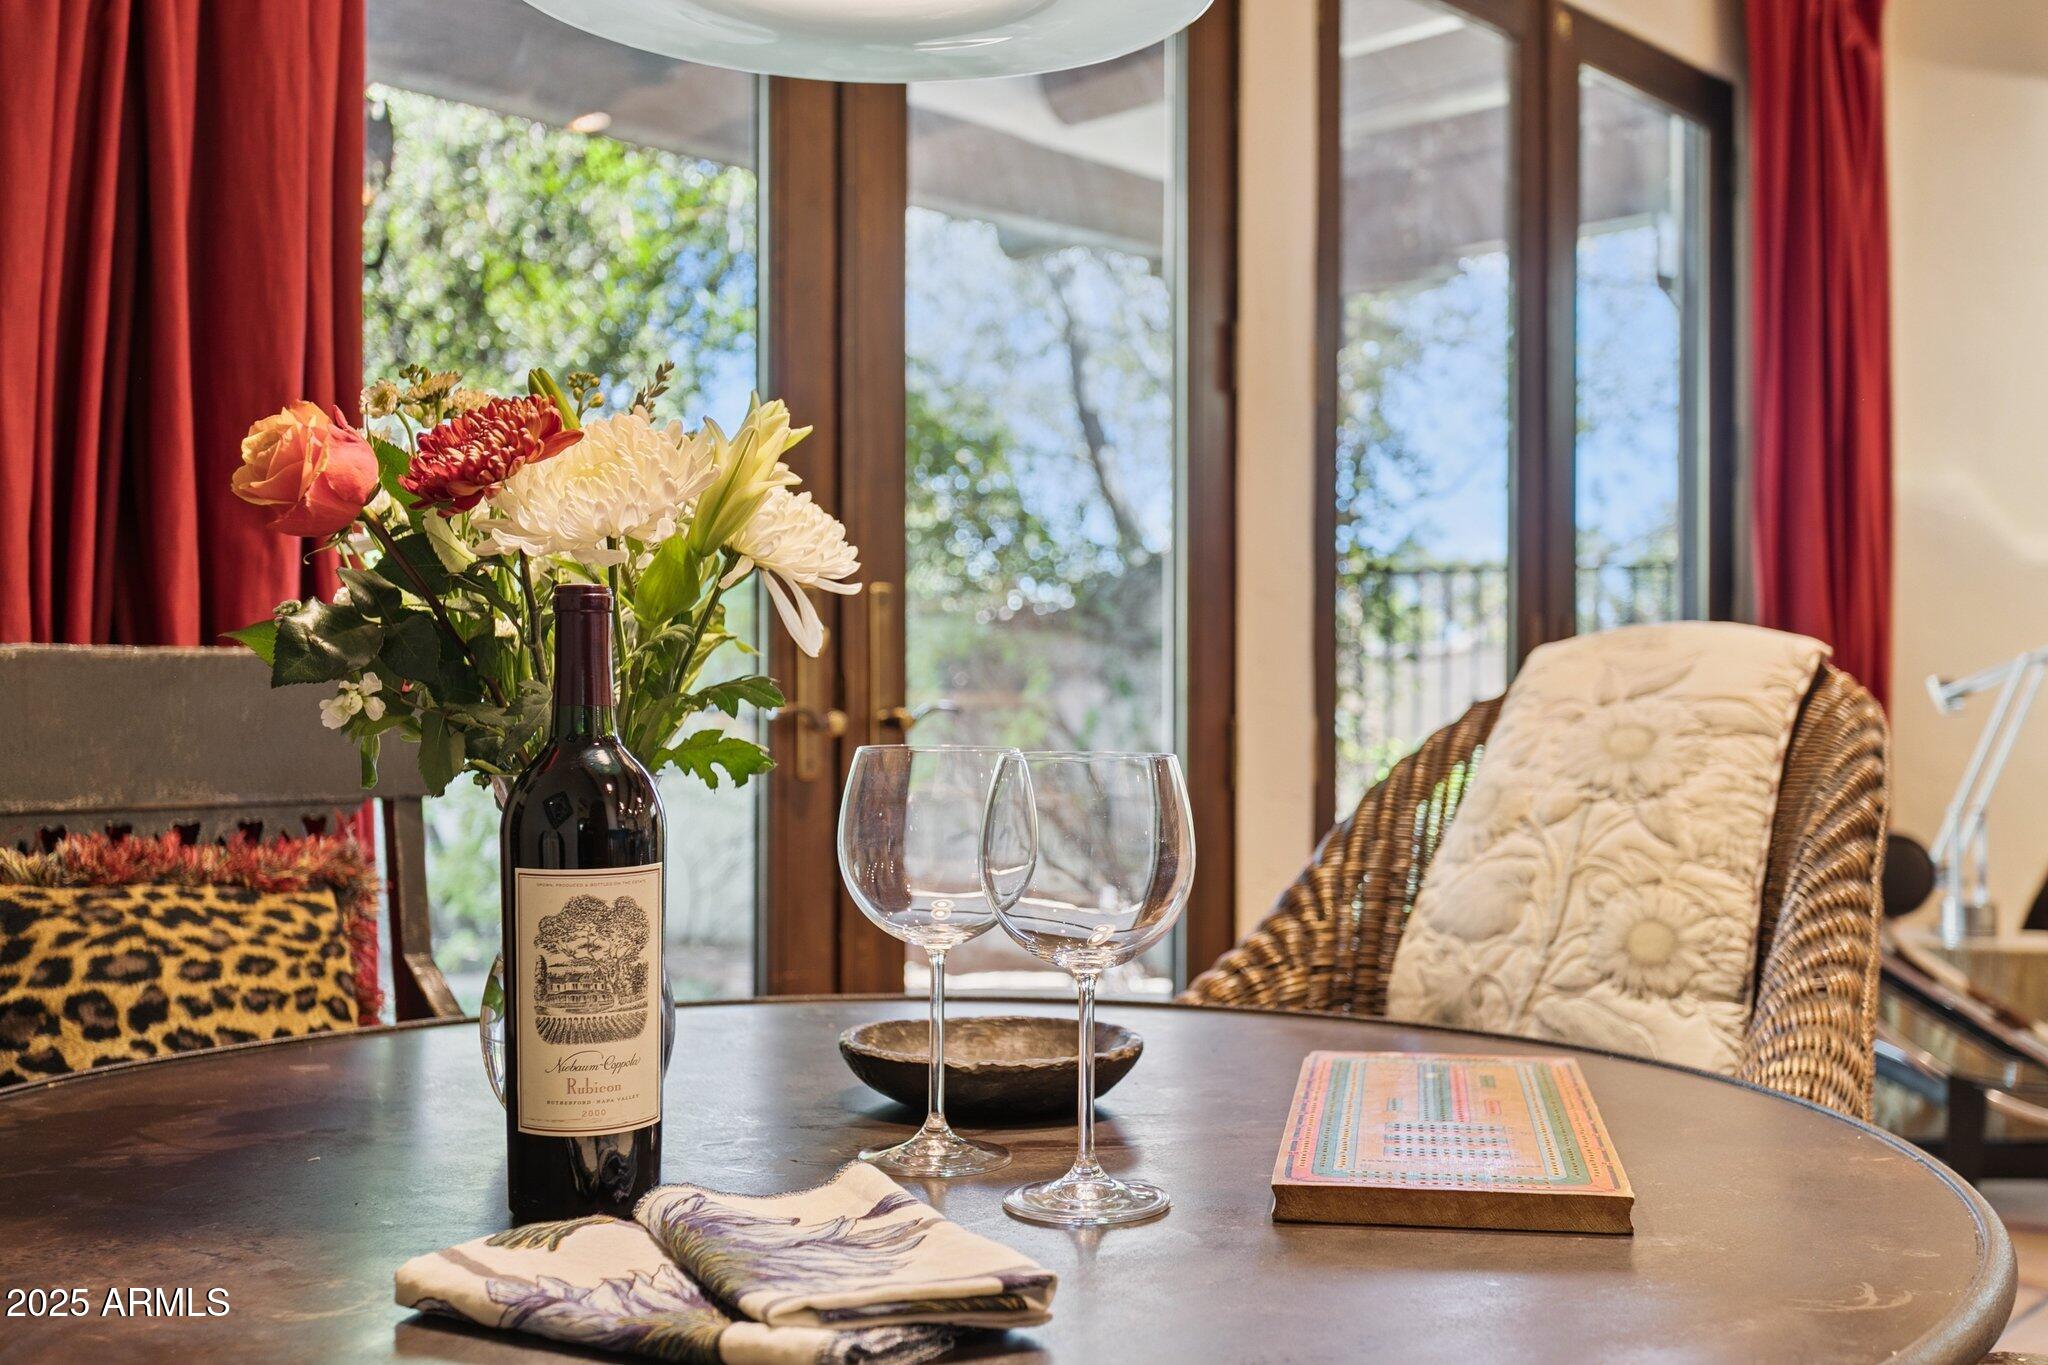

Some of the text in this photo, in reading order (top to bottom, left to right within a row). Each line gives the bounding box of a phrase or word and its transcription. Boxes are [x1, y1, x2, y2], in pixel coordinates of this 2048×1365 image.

[566, 1077, 622, 1095] Rubicon
[617, 1094, 640, 1103] VALLEY
[581, 1108, 607, 1118] 2000
